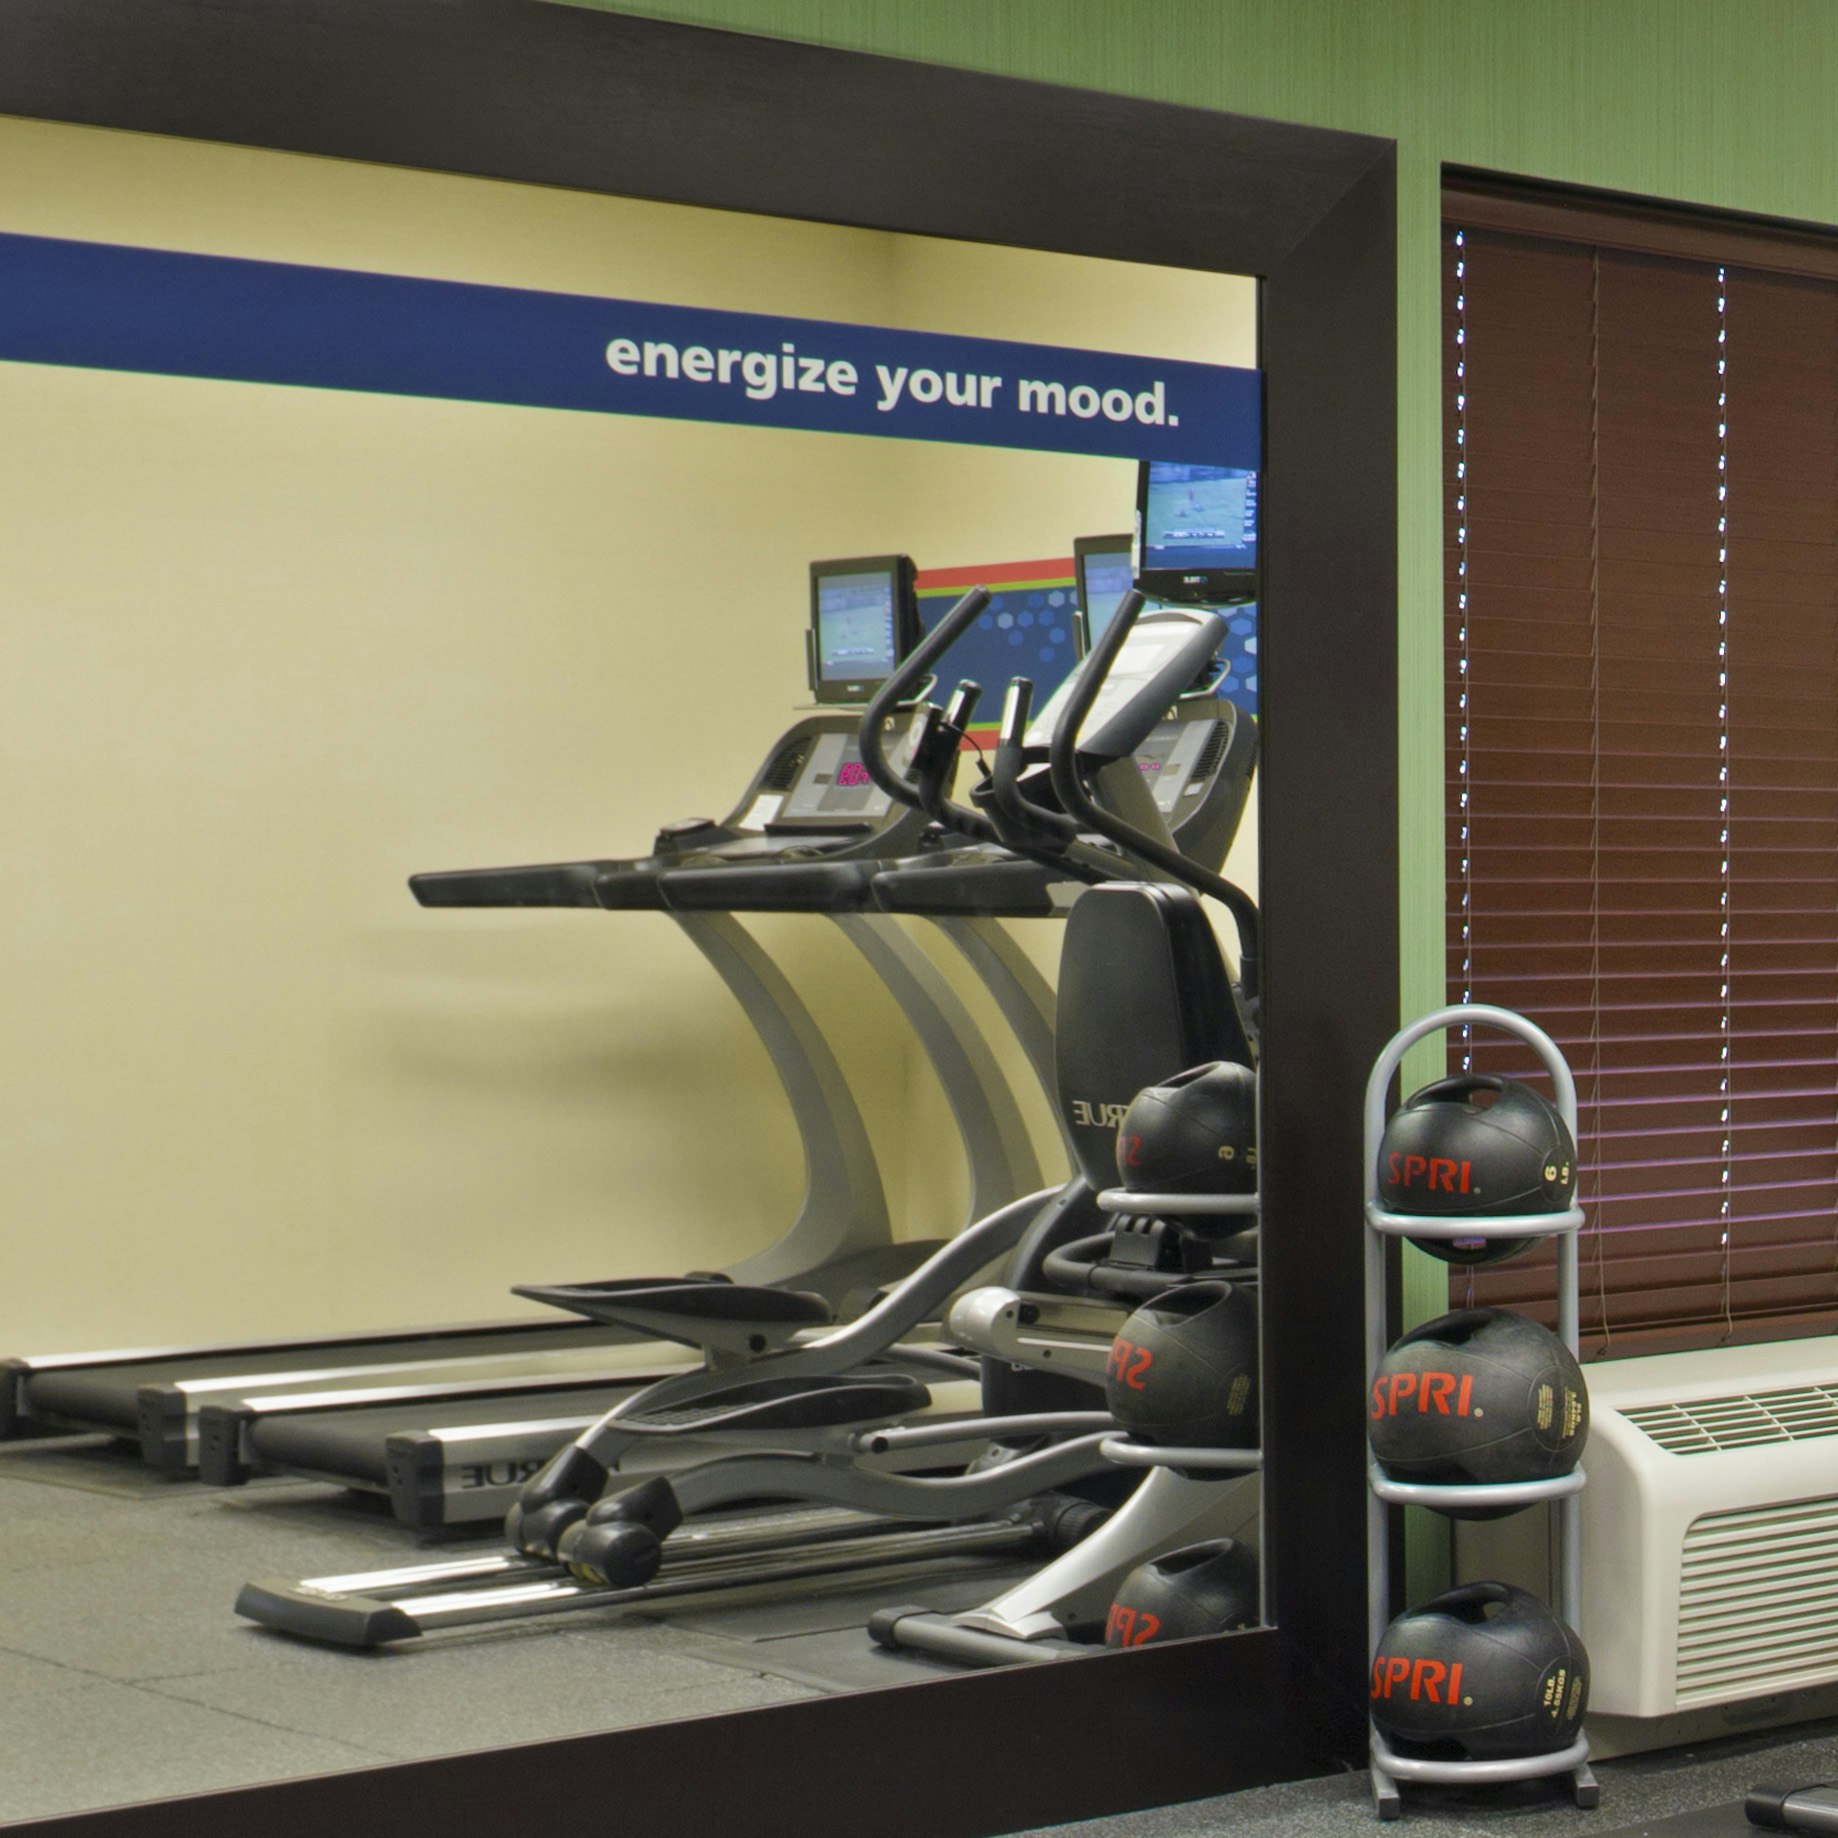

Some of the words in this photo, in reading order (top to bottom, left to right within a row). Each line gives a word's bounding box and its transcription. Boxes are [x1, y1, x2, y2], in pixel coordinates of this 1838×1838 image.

[605, 337, 858, 401] energize
[875, 364, 1003, 413] your
[1017, 380, 1180, 427] mood.
[1388, 1152, 1472, 1194] SPRI
[1372, 1373, 1476, 1420] SPRI
[1371, 1655, 1463, 1707] SPRI
